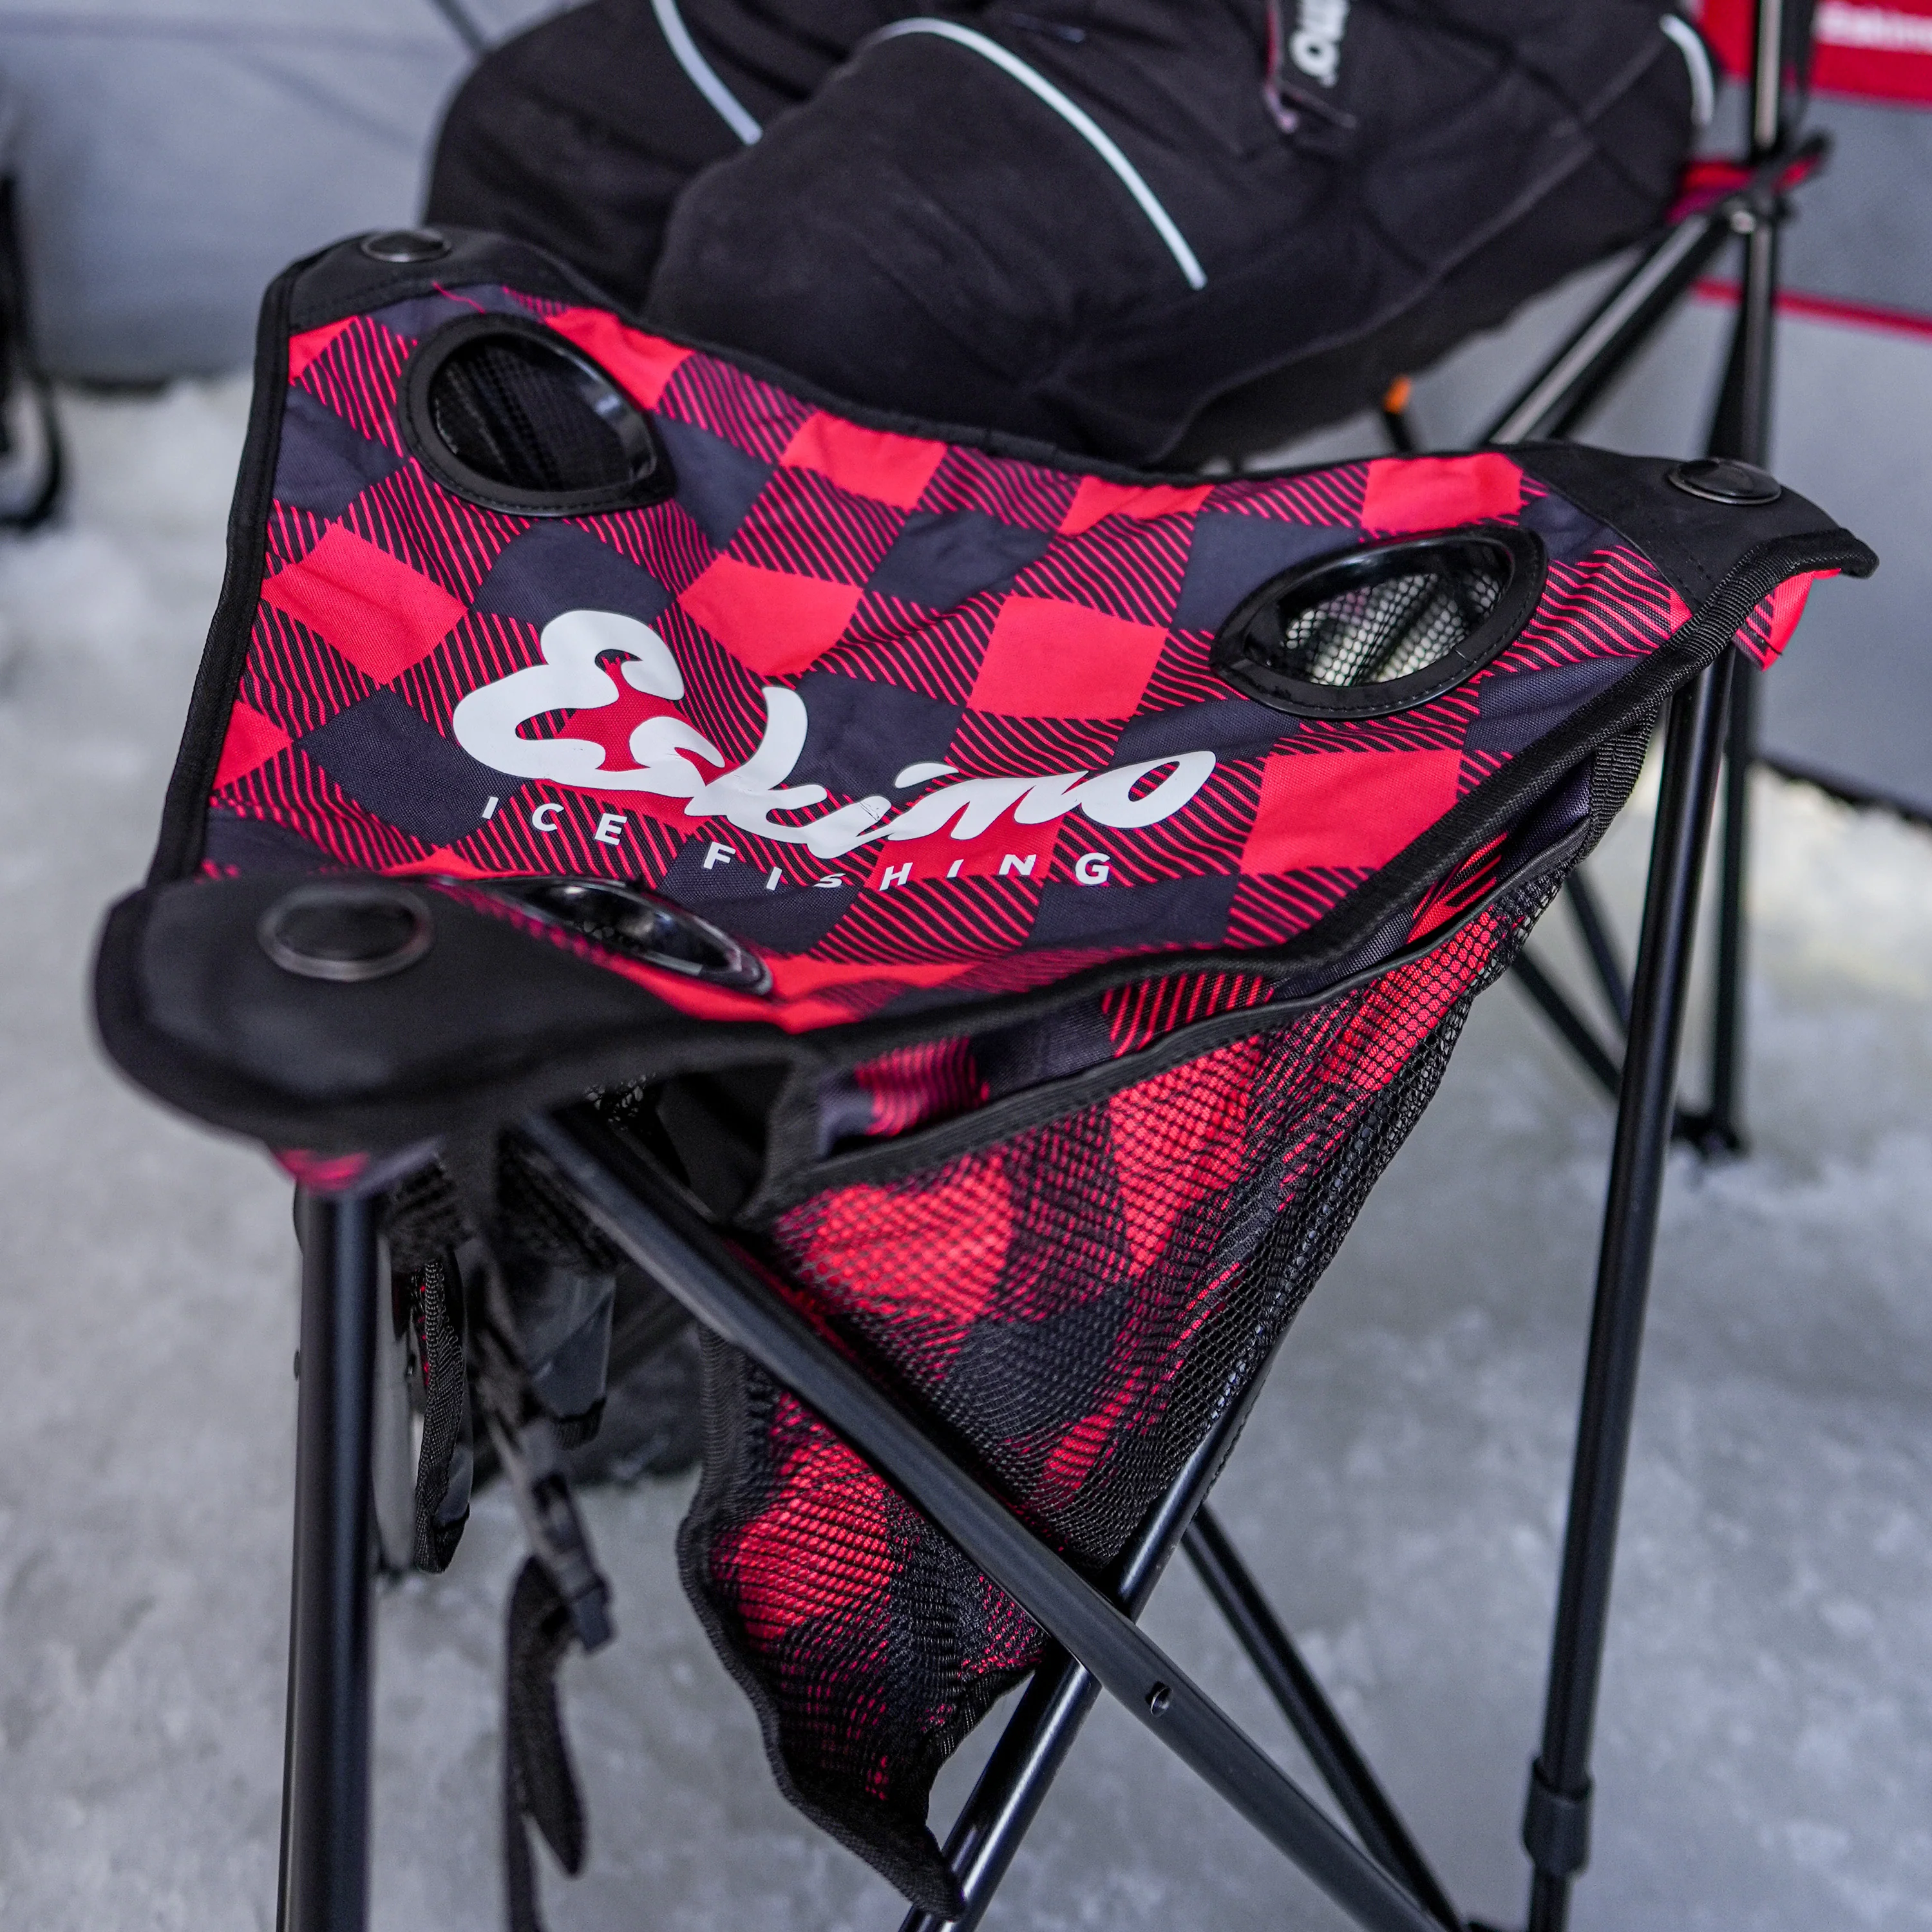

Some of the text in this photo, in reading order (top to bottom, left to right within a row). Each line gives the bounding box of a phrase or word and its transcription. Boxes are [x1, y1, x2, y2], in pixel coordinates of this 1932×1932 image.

[453, 610, 1217, 859] Eskimo
[481, 796, 1110, 891] ICE FISHING
